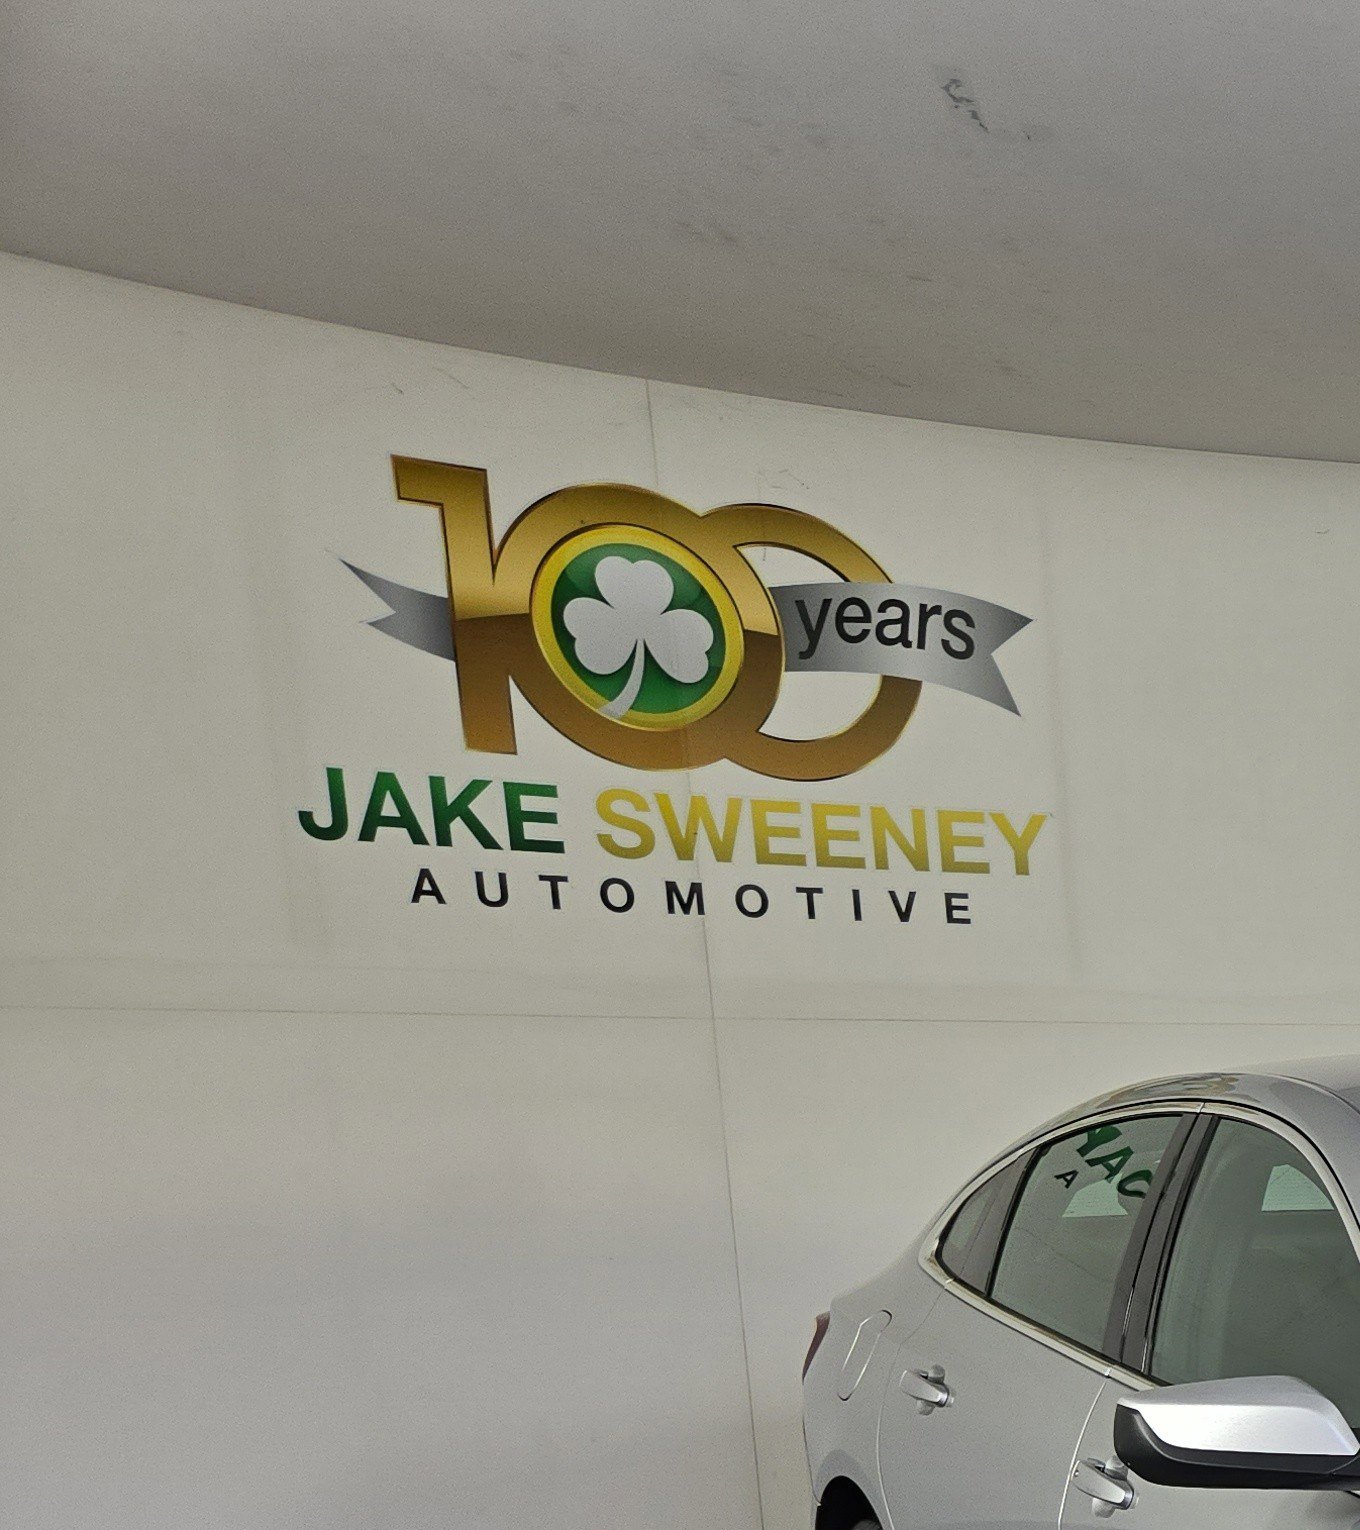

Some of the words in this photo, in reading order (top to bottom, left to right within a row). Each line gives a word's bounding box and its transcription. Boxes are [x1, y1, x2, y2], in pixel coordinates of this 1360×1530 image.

[391, 454, 922, 781] 100
[795, 596, 976, 660] years
[298, 767, 566, 854] JAKE
[595, 788, 1048, 876] SWEENEY
[411, 868, 972, 925] AUTOMOTIVE
